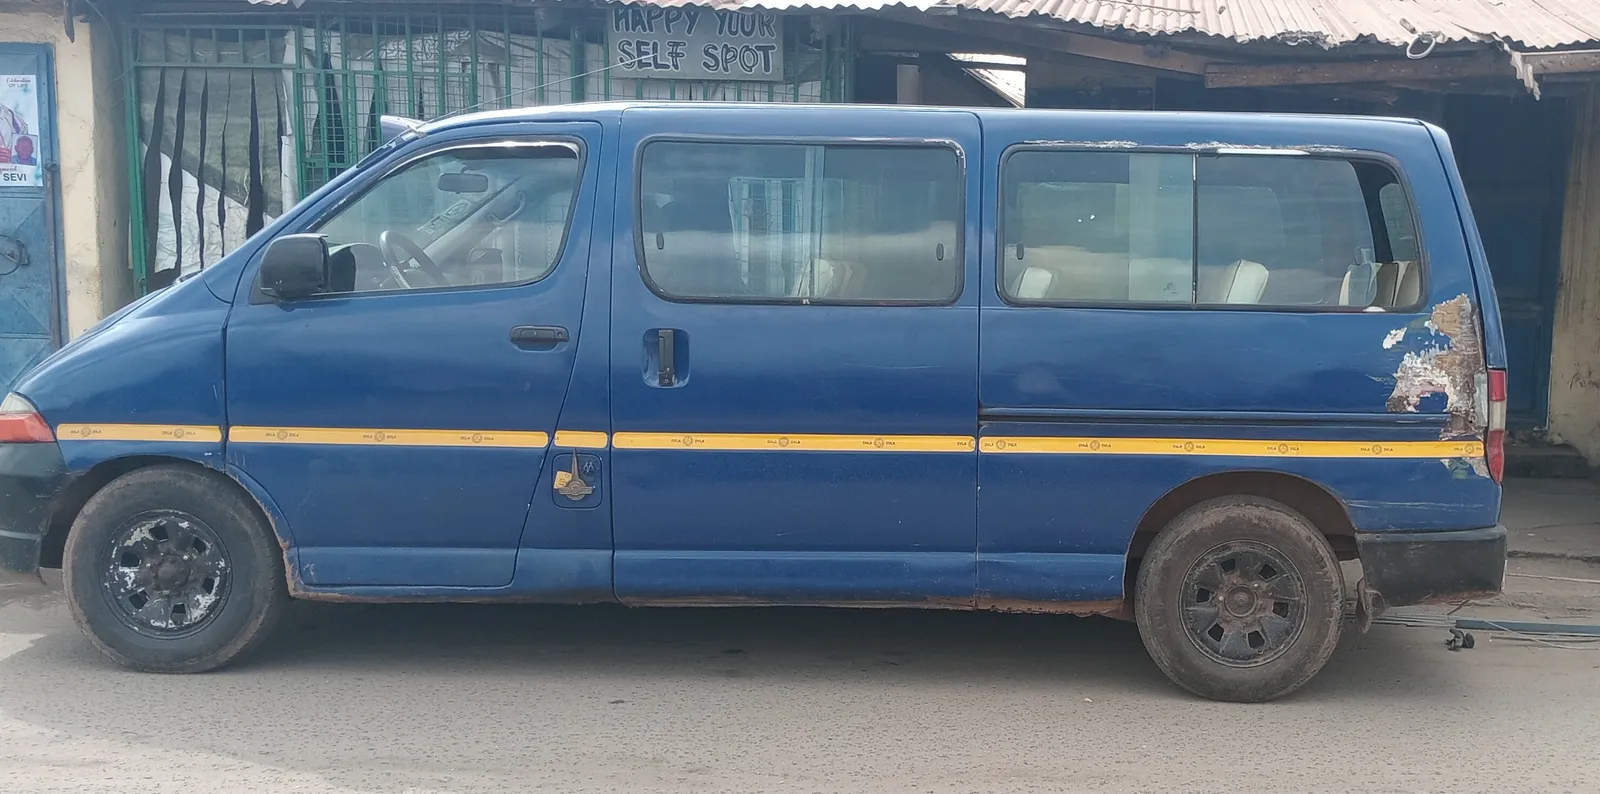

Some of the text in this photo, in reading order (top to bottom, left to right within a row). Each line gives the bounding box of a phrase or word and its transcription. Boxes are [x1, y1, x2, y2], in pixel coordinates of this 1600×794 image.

[613, 8, 700, 36] HAPPY
[618, 40, 777, 74] SELF SPOT
[3, 173, 27, 181] SEVI
